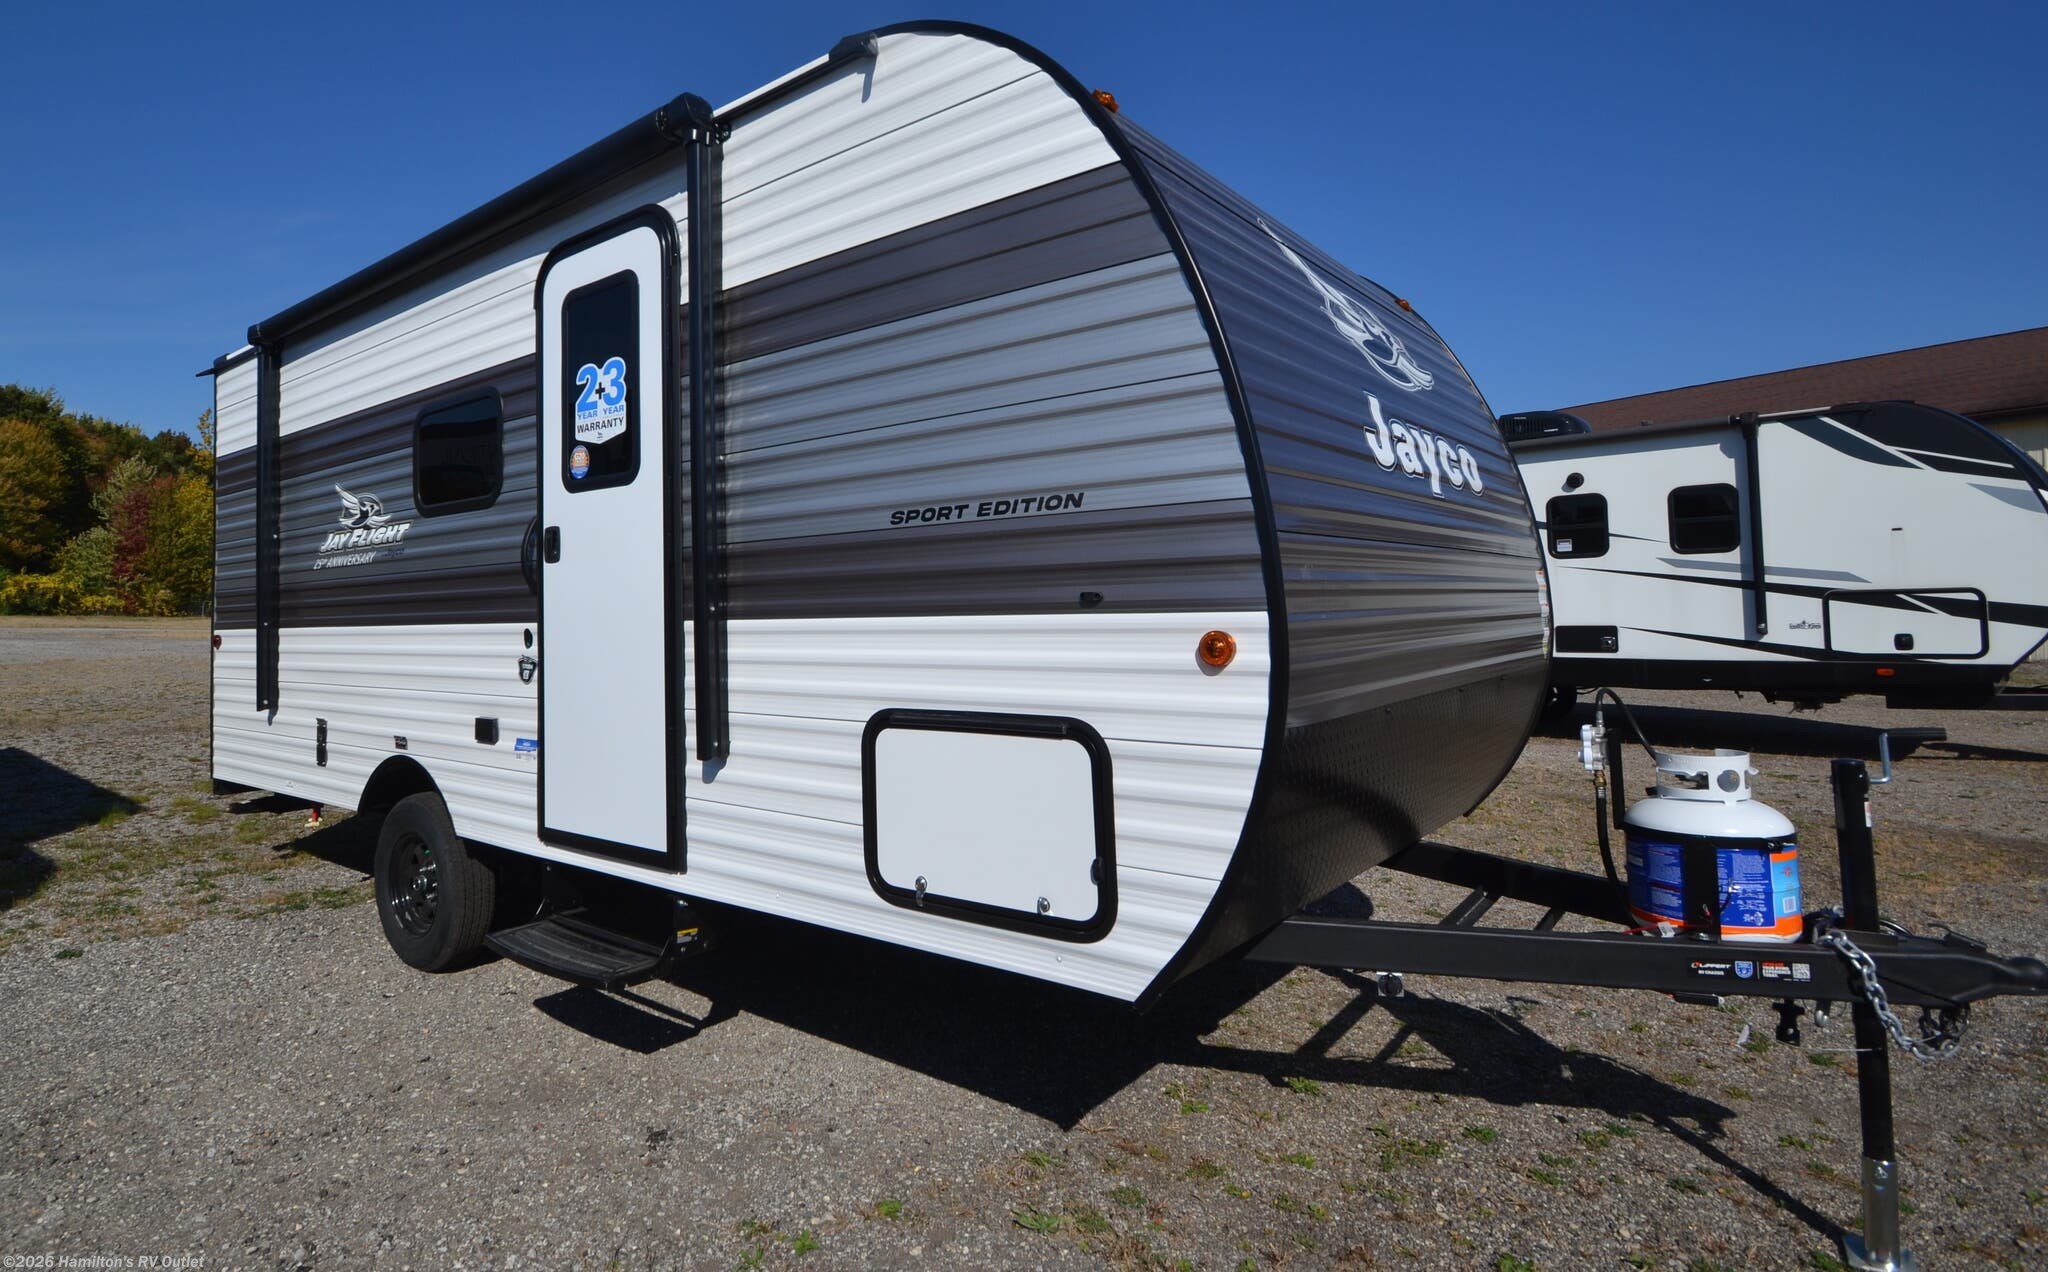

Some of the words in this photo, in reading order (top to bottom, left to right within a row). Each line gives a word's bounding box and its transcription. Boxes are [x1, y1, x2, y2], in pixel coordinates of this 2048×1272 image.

[577, 410, 598, 420] YEAR
[602, 404, 625, 415] YEAR
[577, 417, 624, 433] WARRANTY
[1363, 391, 1484, 498] Jayco
[890, 504, 969, 526] SPORT
[976, 492, 1084, 518] EDITION
[319, 532, 350, 552] JAY
[348, 523, 411, 548] FLIGHT
[325, 551, 377, 568] ANNIVERSARY
